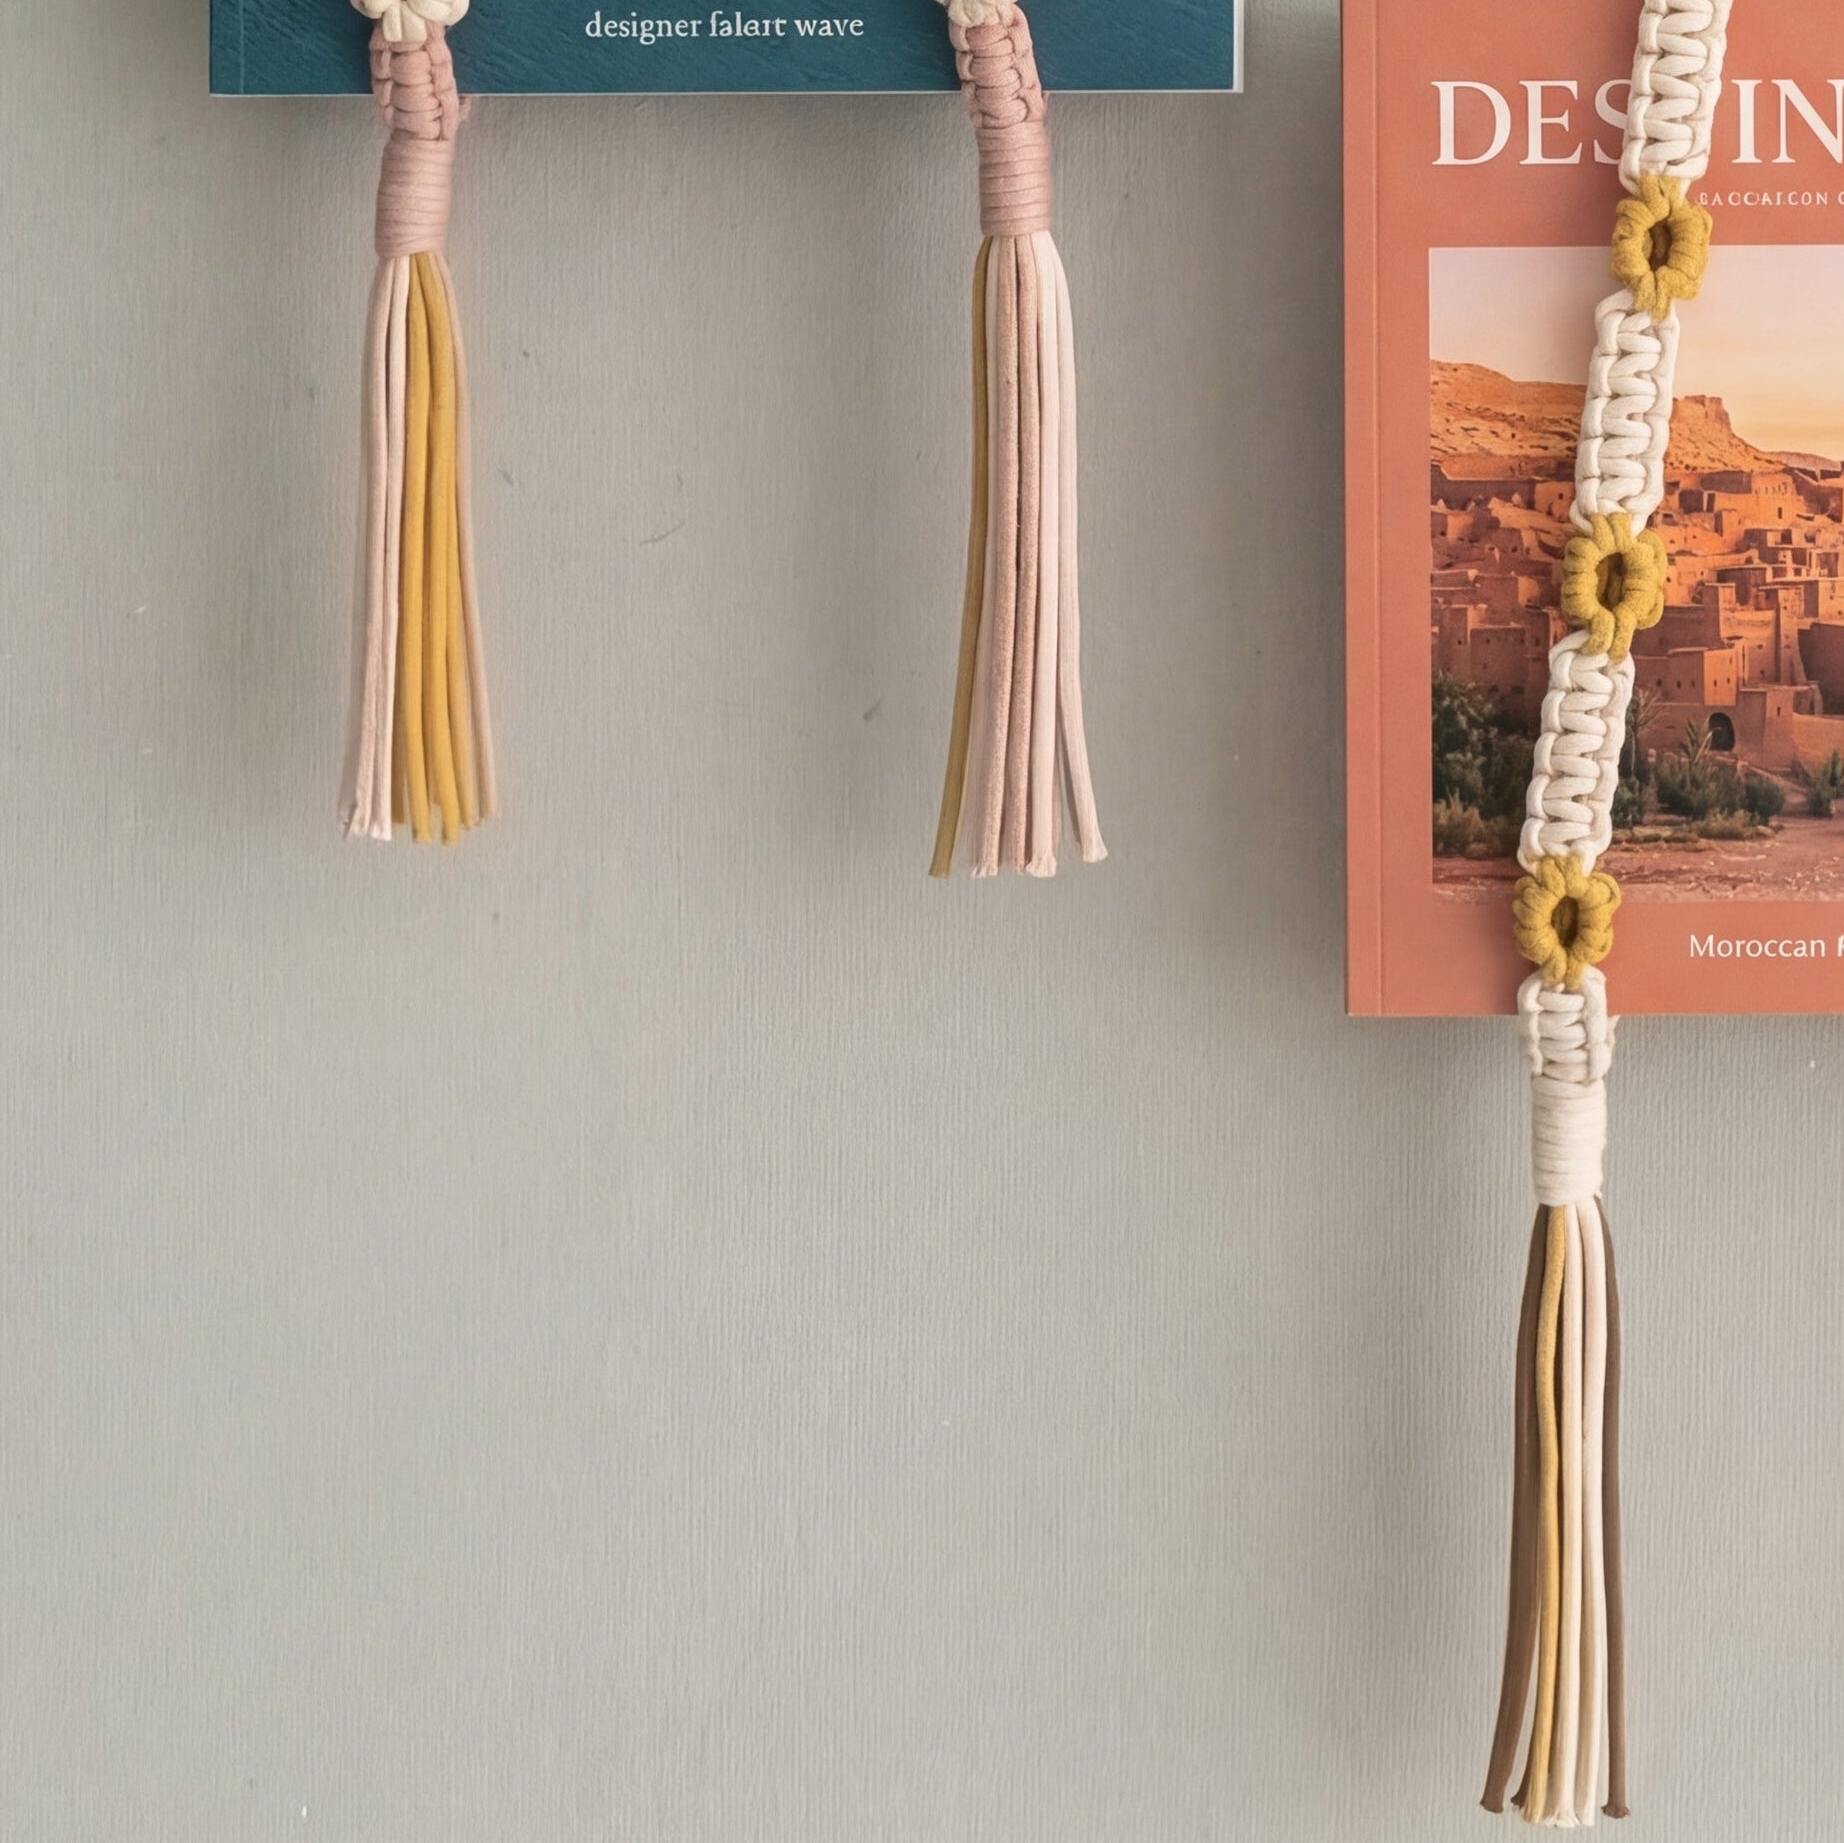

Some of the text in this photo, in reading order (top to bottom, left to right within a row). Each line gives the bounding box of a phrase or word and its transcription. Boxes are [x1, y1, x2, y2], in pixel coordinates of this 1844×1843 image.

[585, 10, 702, 45] designer
[793, 18, 865, 37] wave
[1689, 934, 1826, 958] Moroccan
